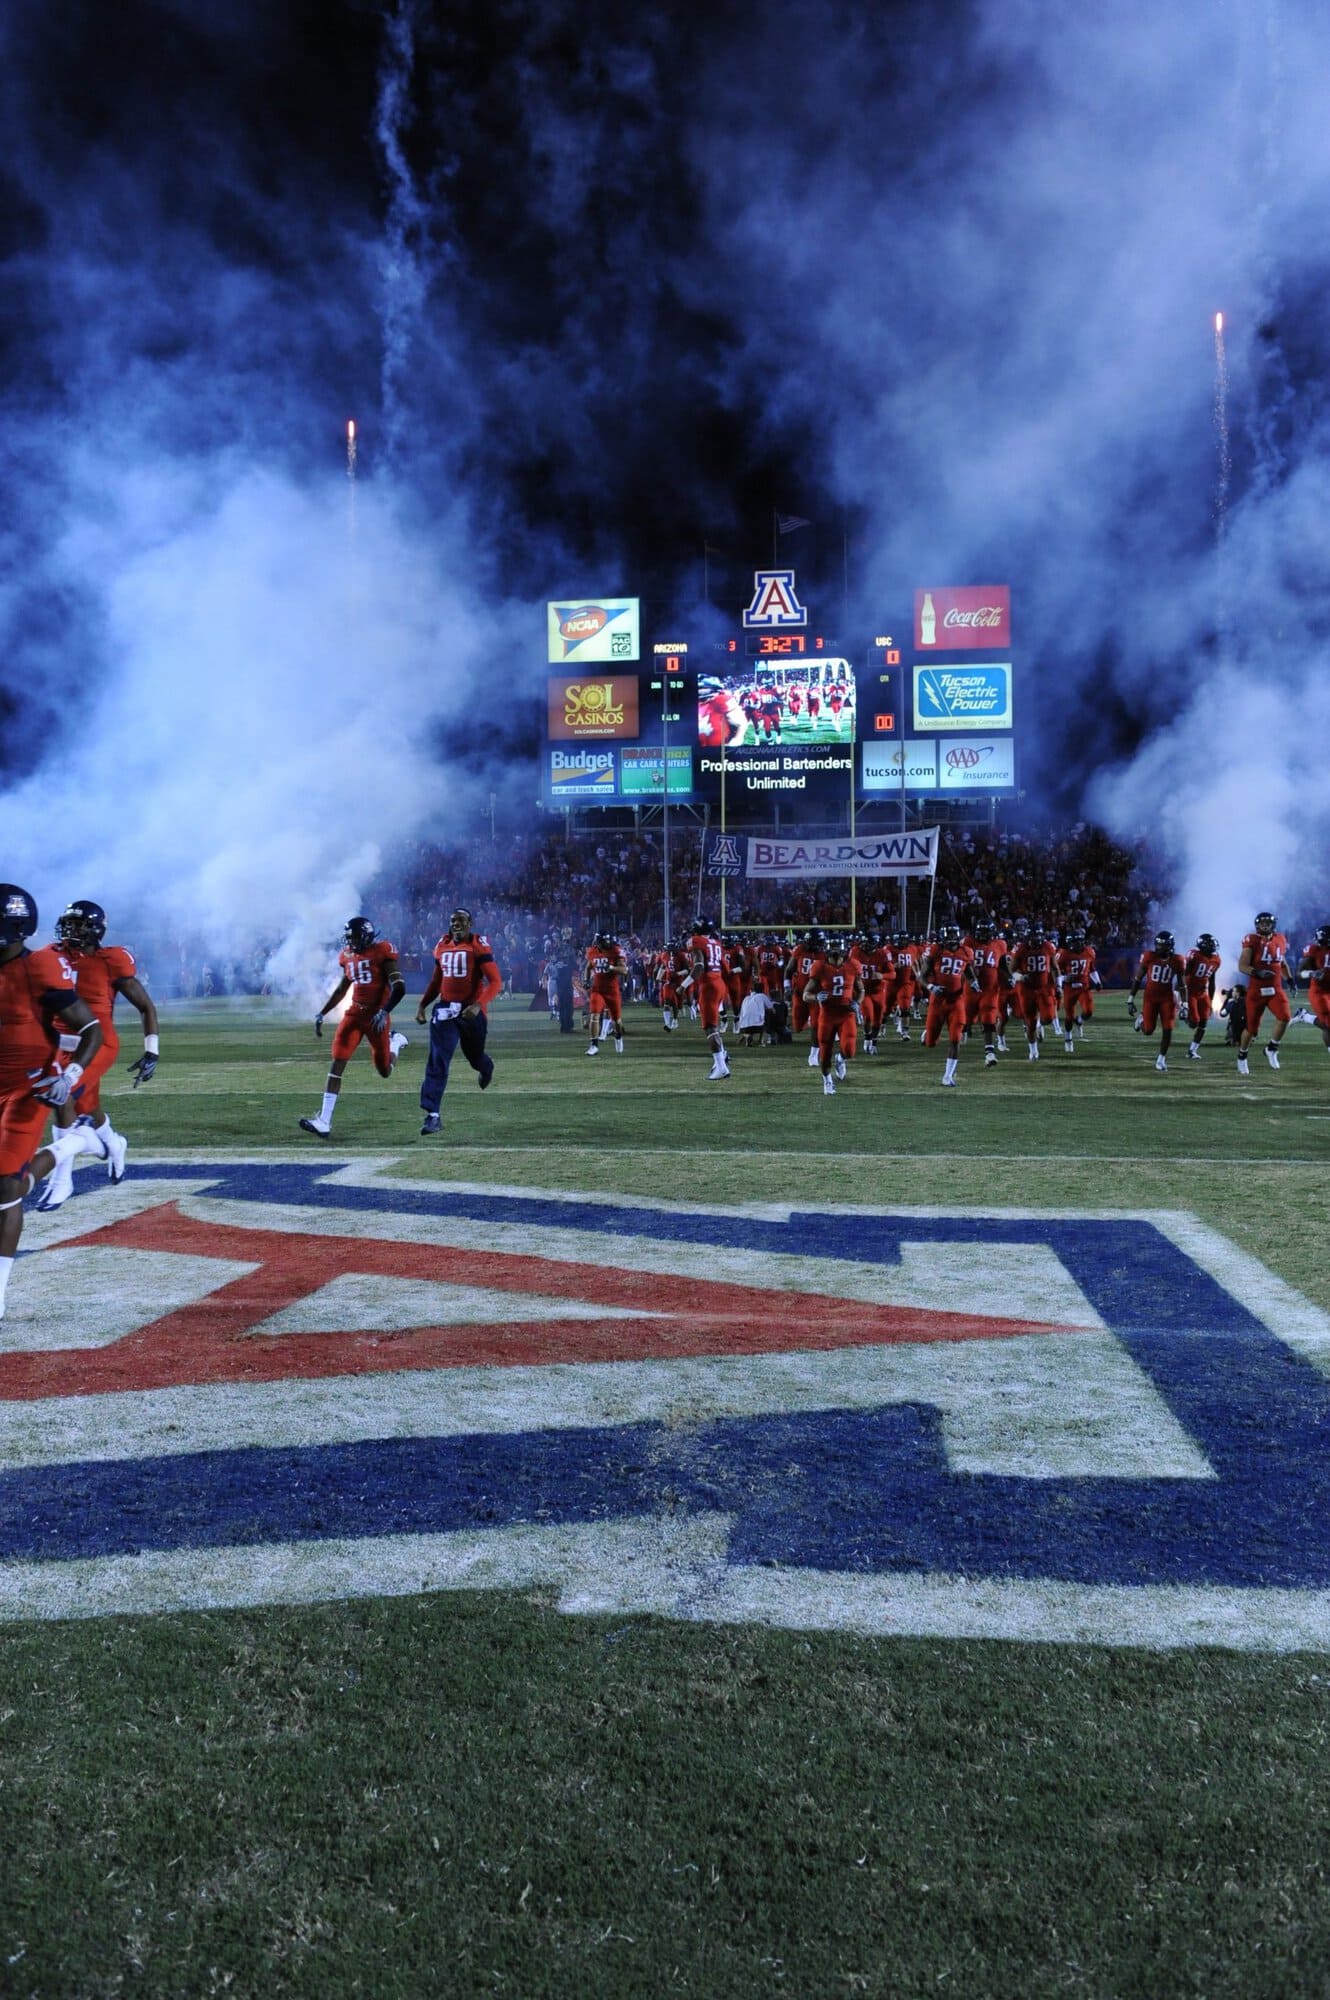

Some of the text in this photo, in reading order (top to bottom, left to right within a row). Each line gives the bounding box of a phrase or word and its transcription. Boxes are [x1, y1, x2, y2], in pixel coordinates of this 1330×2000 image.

[743, 570, 806, 627] A
[943, 607, 1003, 628] Coca-Cola
[567, 619, 599, 633] NCAA
[728, 640, 736, 651] 3
[759, 636, 805, 653] 3:27
[875, 637, 893, 646] USC
[666, 656, 679, 671] 0
[940, 674, 986, 687] Tucson
[564, 683, 624, 713] SOL
[944, 686, 999, 699] Electric
[950, 698, 998, 711] Power
[564, 711, 624, 726] CASINOS
[551, 750, 614, 773] Budget
[700, 756, 852, 772] Professional Bartenders
[947, 749, 978, 768] AAA
[865, 766, 934, 778] tucson.com
[746, 776, 806, 790] Unlimited
[706, 944, 721, 966] 18
[974, 950, 996, 968] 54
[348, 960, 372, 984] 16
[441, 951, 467, 978] 90
[1027, 956, 1046, 972] 92
[1071, 960, 1086, 975] 27
[1151, 965, 1171, 983] 80
[832, 976, 845, 997] 2
